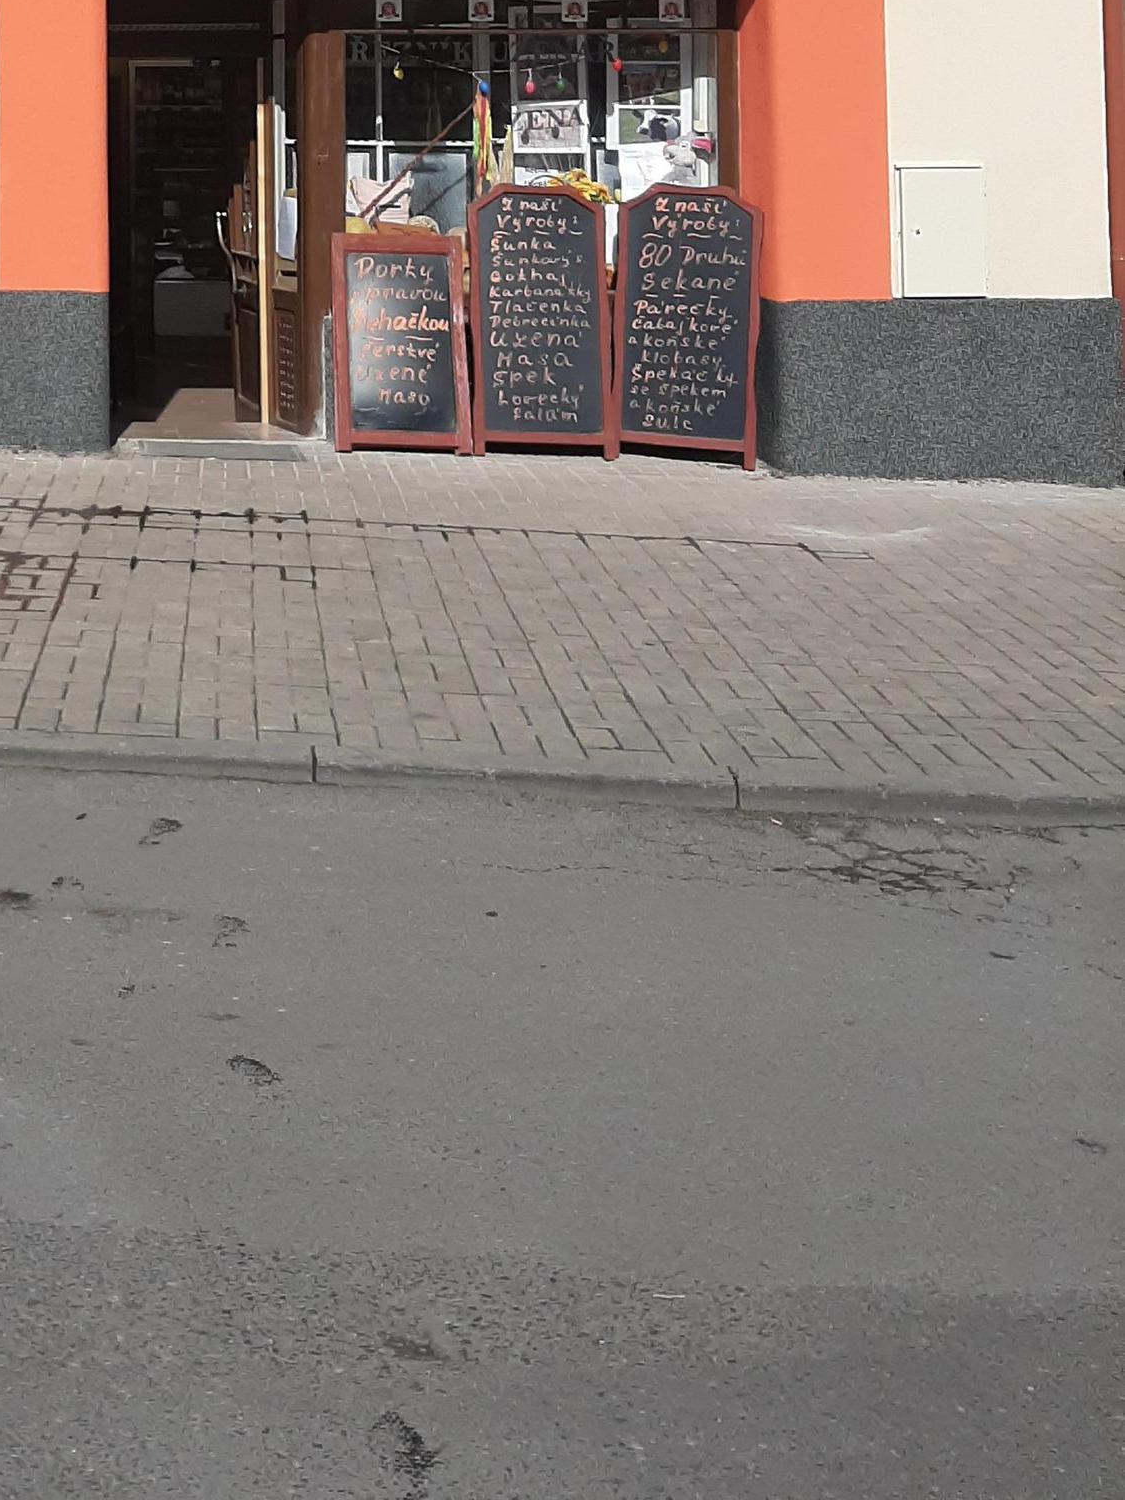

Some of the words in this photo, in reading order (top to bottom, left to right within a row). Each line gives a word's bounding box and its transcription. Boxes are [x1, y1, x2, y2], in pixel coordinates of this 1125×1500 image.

[638, 242, 672, 269] 80
[628, 336, 638, 345] a
[629, 399, 641, 410] a
